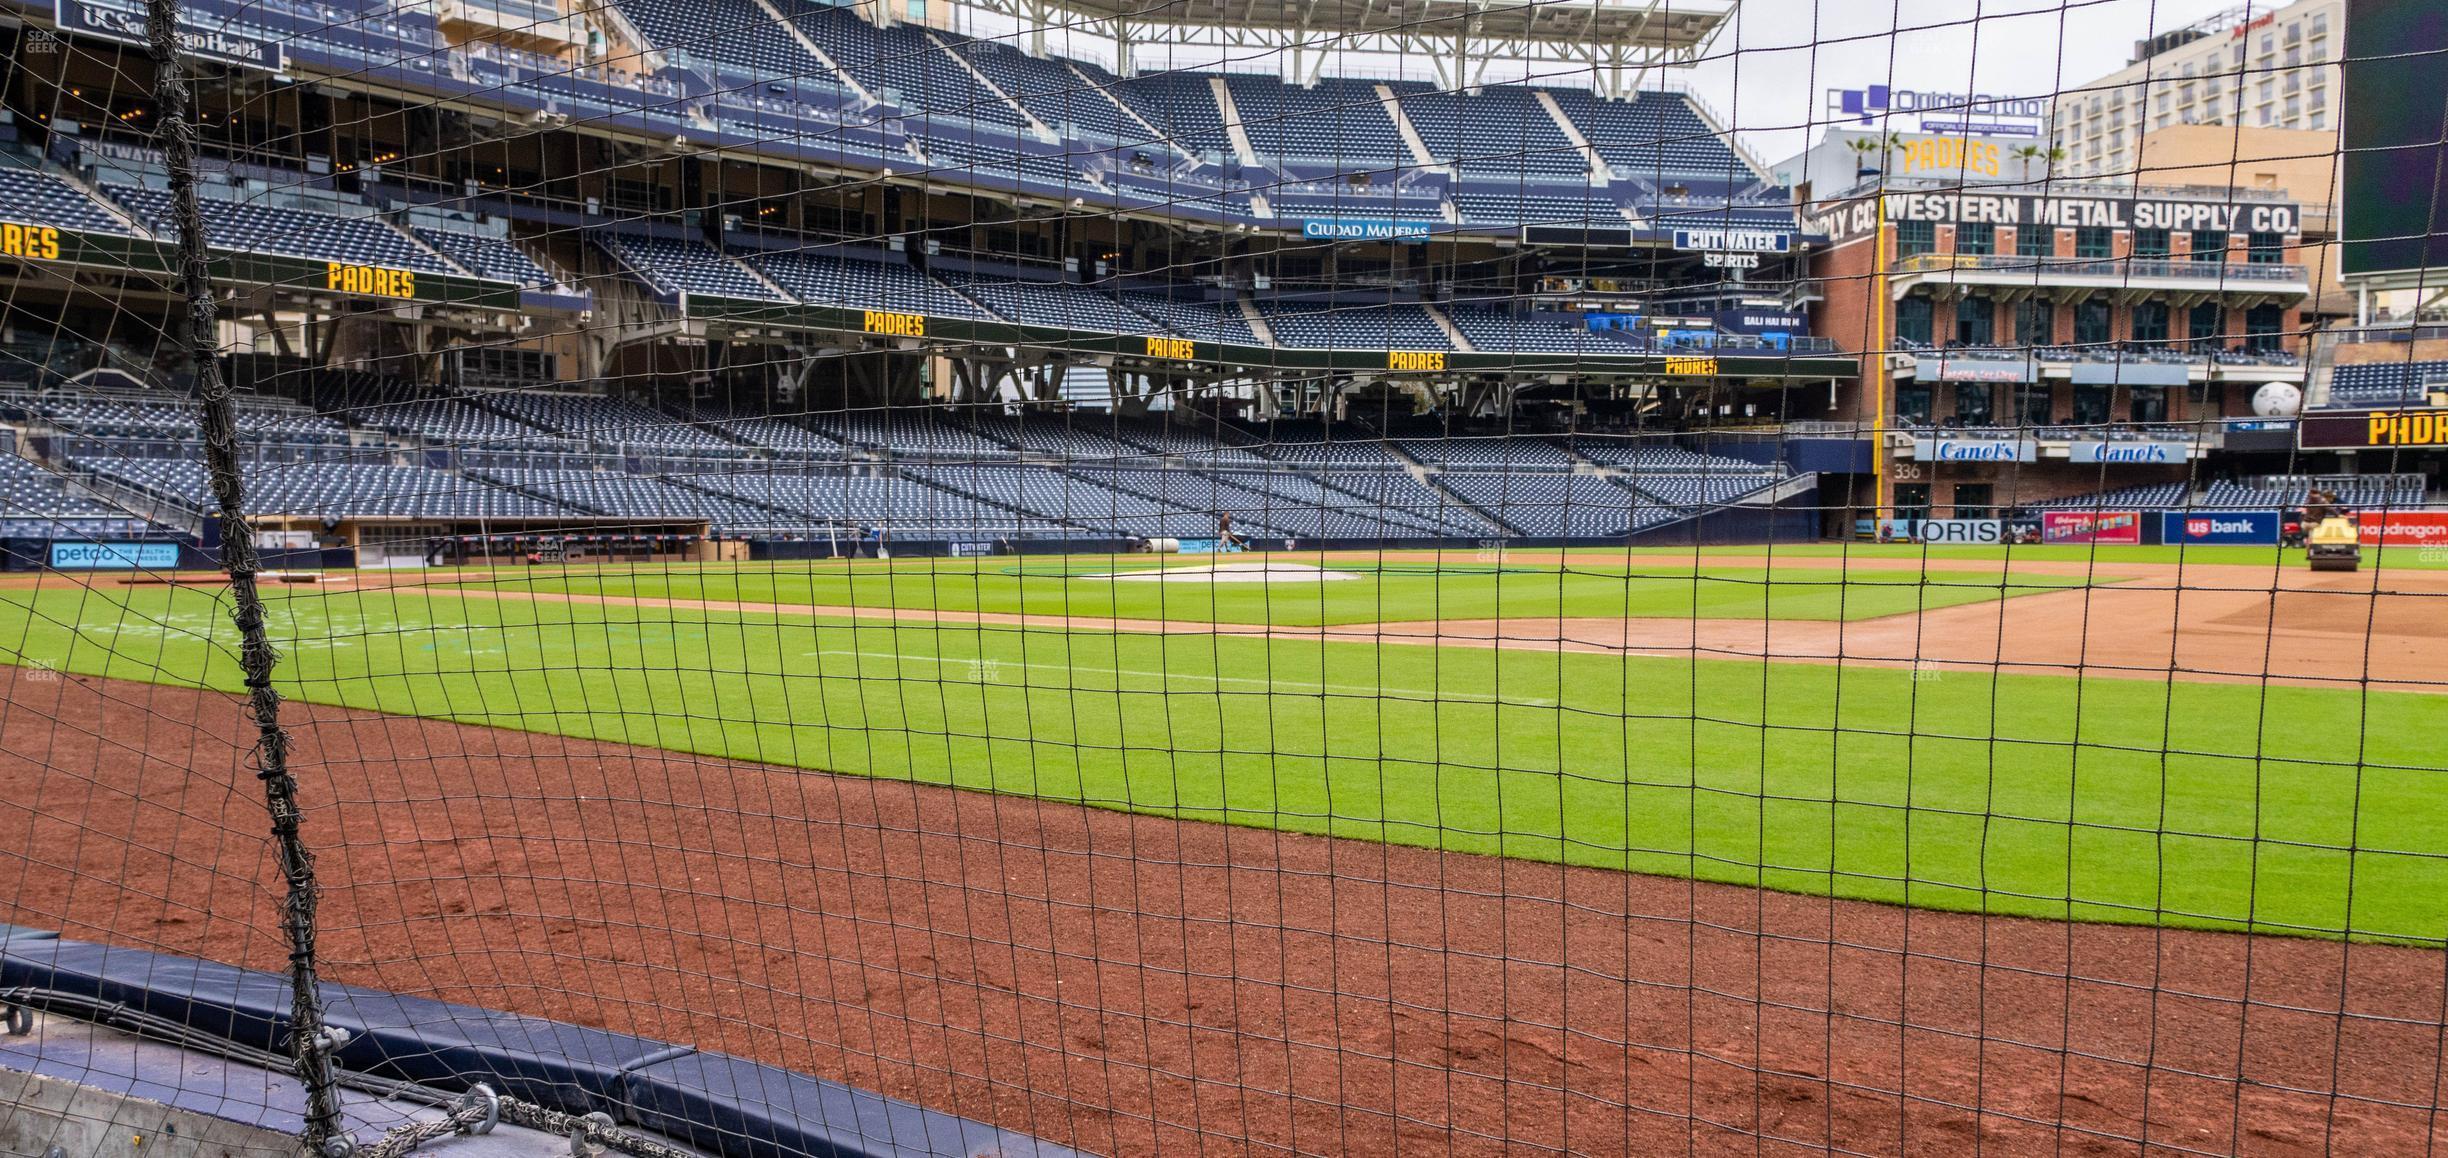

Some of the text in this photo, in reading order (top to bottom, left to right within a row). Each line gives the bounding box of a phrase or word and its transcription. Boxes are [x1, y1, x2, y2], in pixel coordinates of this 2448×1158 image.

[206, 32, 263, 60] Health
[1904, 138, 1999, 176] PADRES
[1884, 194, 2297, 233] WESTERN METAL SUPPLY CO.
[1307, 222, 1362, 236] CIUDAD
[0, 222, 60, 260] RES
[1687, 231, 1777, 251] CUTWATER
[1704, 253, 1759, 268] SPIRITS
[328, 262, 415, 298] PADRES
[864, 310, 924, 337] PADRES
[1744, 316, 1763, 326] BALI
[1765, 317, 1780, 326] HAI
[1147, 336, 1194, 359] PADRES
[1389, 351, 1444, 371] PADRES
[1665, 356, 1718, 376] PADRES
[1939, 441, 2014, 460] Canel's
[2094, 443, 2166, 463] Canel's
[1894, 464, 1921, 479] 336
[1922, 522, 1997, 542] ORIS
[2187, 519, 2256, 534] us bank
[2359, 523, 2447, 539] napdragon
[56, 546, 114, 564] petco
